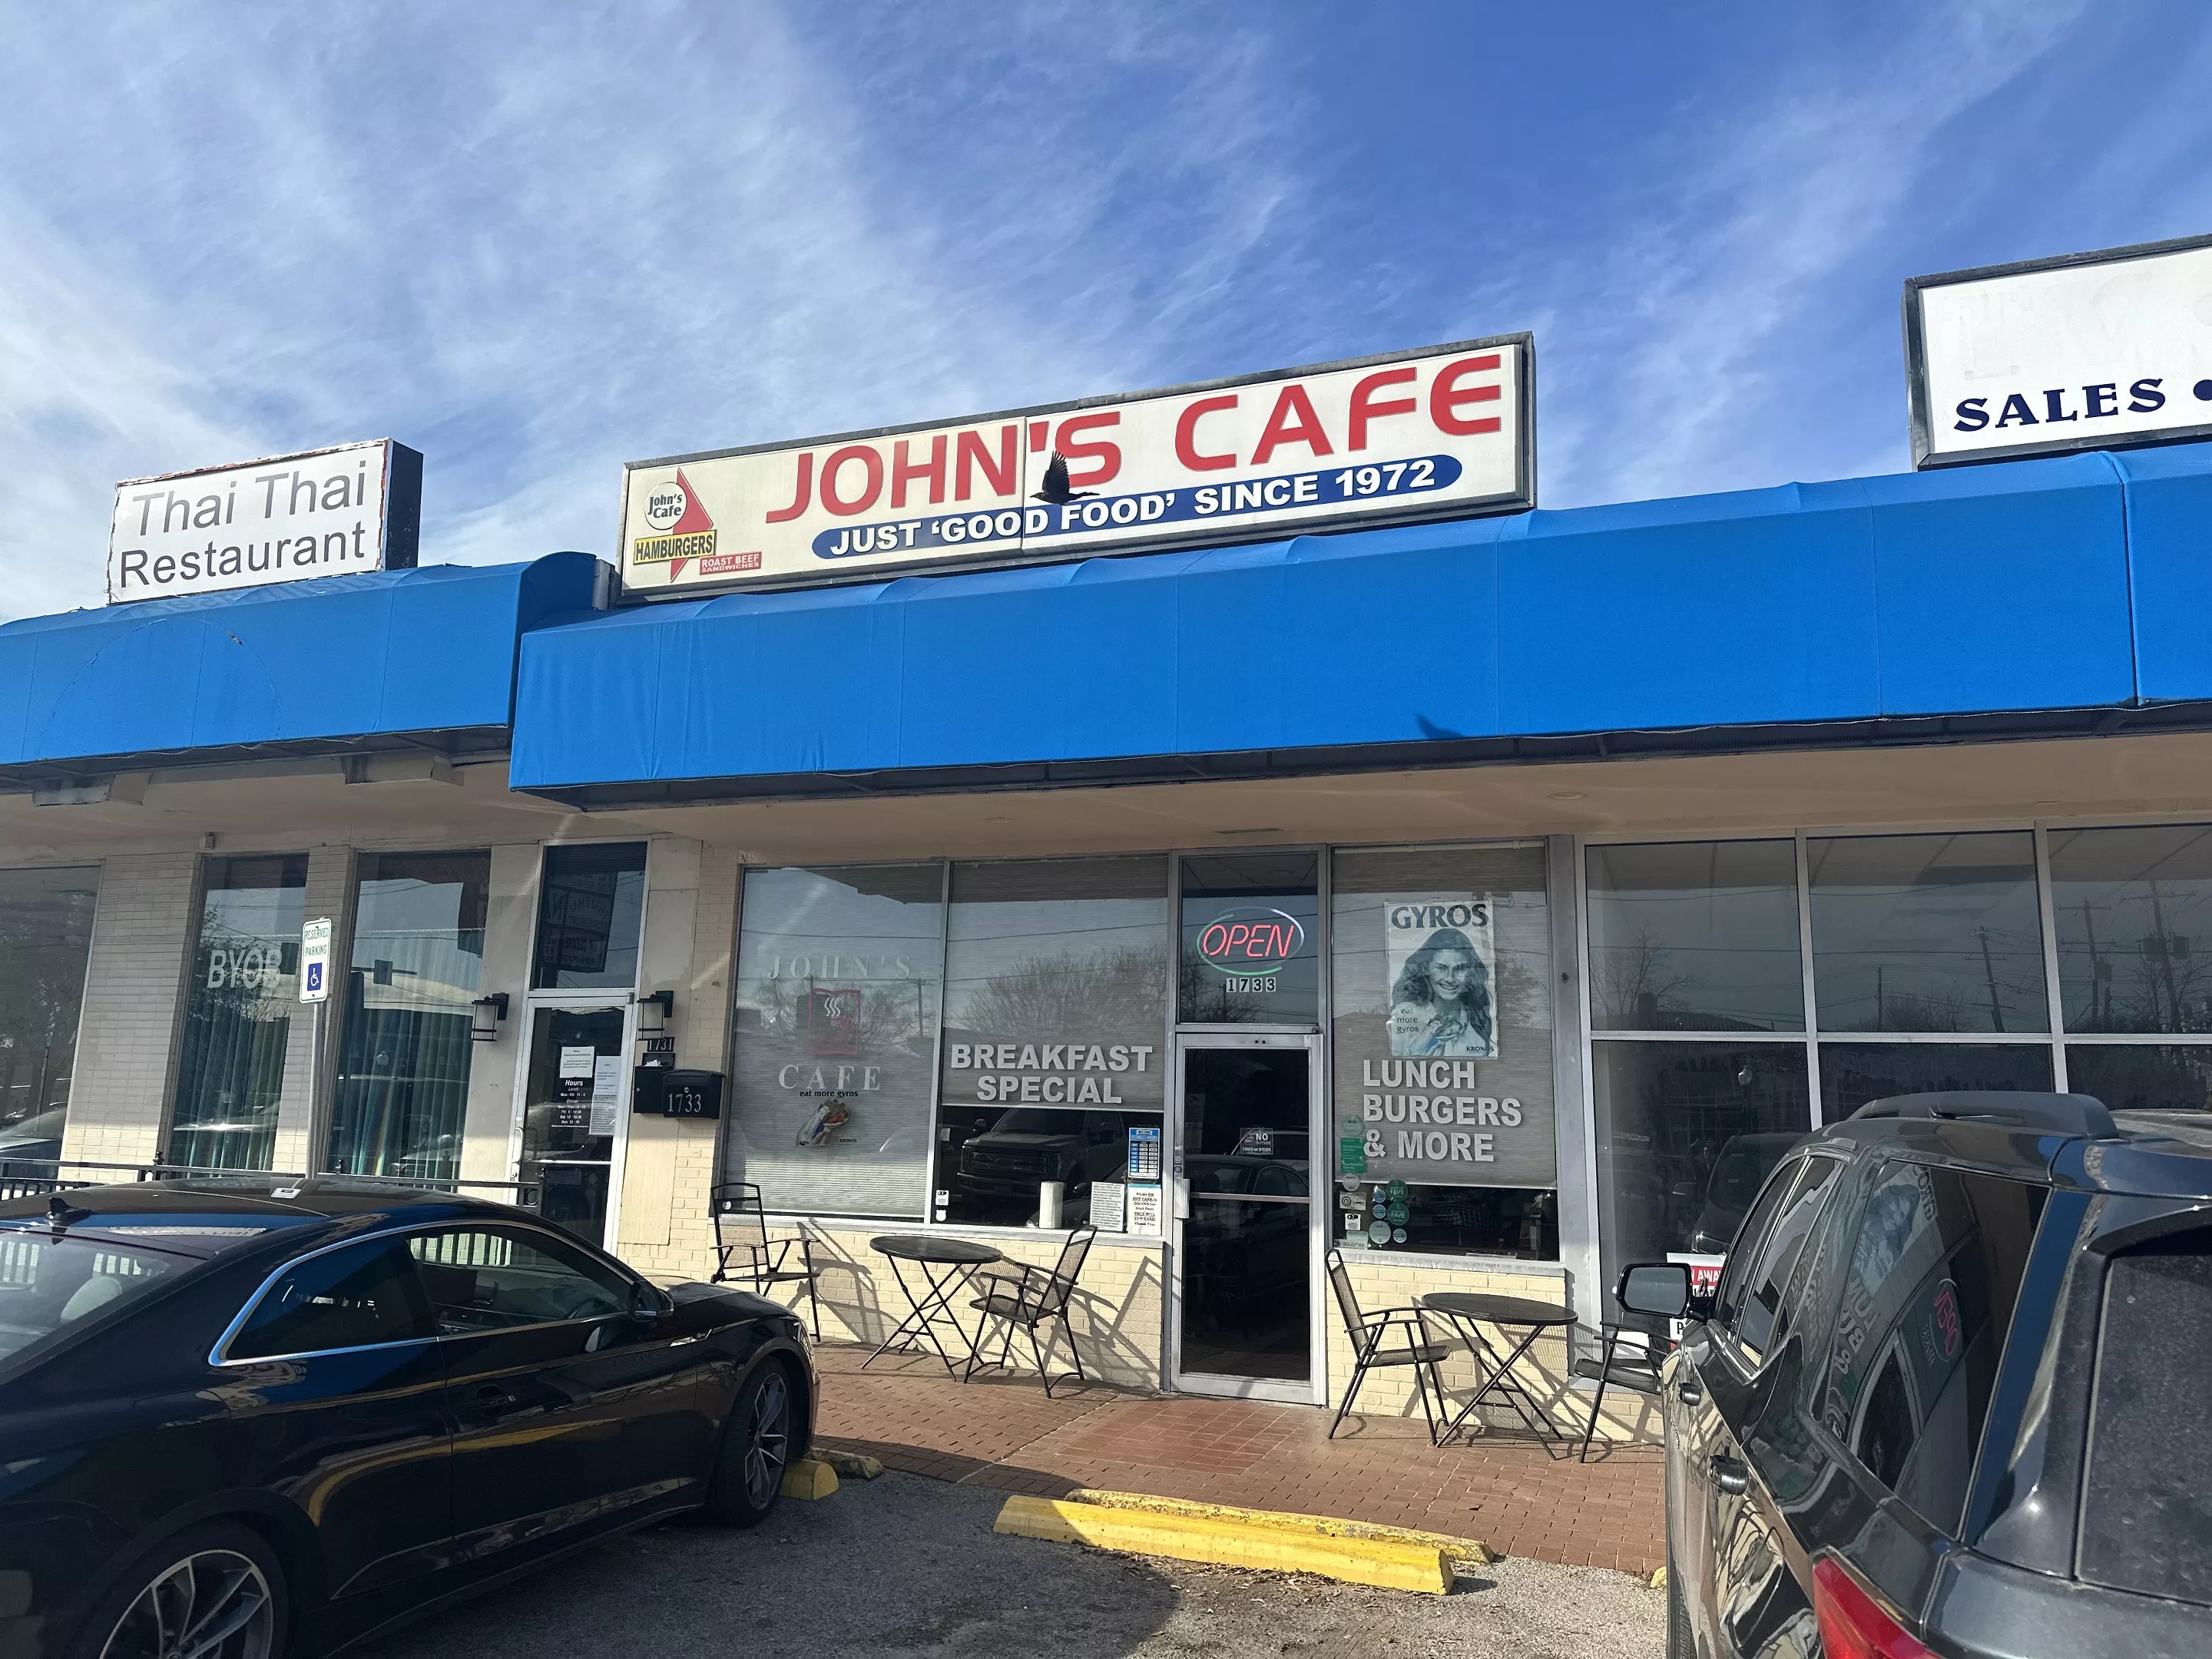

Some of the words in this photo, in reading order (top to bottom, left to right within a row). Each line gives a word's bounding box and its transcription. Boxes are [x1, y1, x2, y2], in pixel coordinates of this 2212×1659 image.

[1953, 378, 2166, 432] SALES
[766, 411, 1121, 523] JOHN'S
[1174, 354, 1502, 472] CAFE
[132, 480, 237, 537] Thai
[255, 460, 367, 519] Thai
[647, 493, 683, 515] John's
[653, 505, 682, 518] Cafe
[830, 522, 921, 556] JUST
[932, 508, 1049, 542] 'GOOD
[1061, 491, 1176, 530] FOOD'
[1194, 472, 1320, 515] SINCE
[1335, 459, 1435, 498] 1972
[120, 520, 366, 588] Restaurant
[635, 535, 713, 561] HAMBURGERS
[701, 556, 733, 568] ROAST
[735, 553, 760, 564] BEEF
[701, 561, 760, 573] SANDWICHES
[1391, 903, 1489, 929] GYROS
[305, 927, 329, 940] RESERVED
[1202, 924, 1295, 957] OPEN
[305, 944, 328, 958] PARKING
[207, 947, 283, 989] BYOB
[768, 955, 912, 979] JOHN'S
[1227, 978, 1276, 992] 1733
[1396, 1025, 1419, 1035] gyros
[648, 1038, 672, 1051] 1731
[951, 1043, 1154, 1071] BREAKFAST
[778, 1064, 881, 1091] CAFE
[1363, 1059, 1475, 1089] LUNCH
[976, 1075, 1122, 1104] SPECIAL
[667, 1093, 701, 1113] 1733
[1363, 1094, 1522, 1127] BURGERS
[1363, 1129, 1386, 1157] &
[1398, 1130, 1494, 1162] MORE
